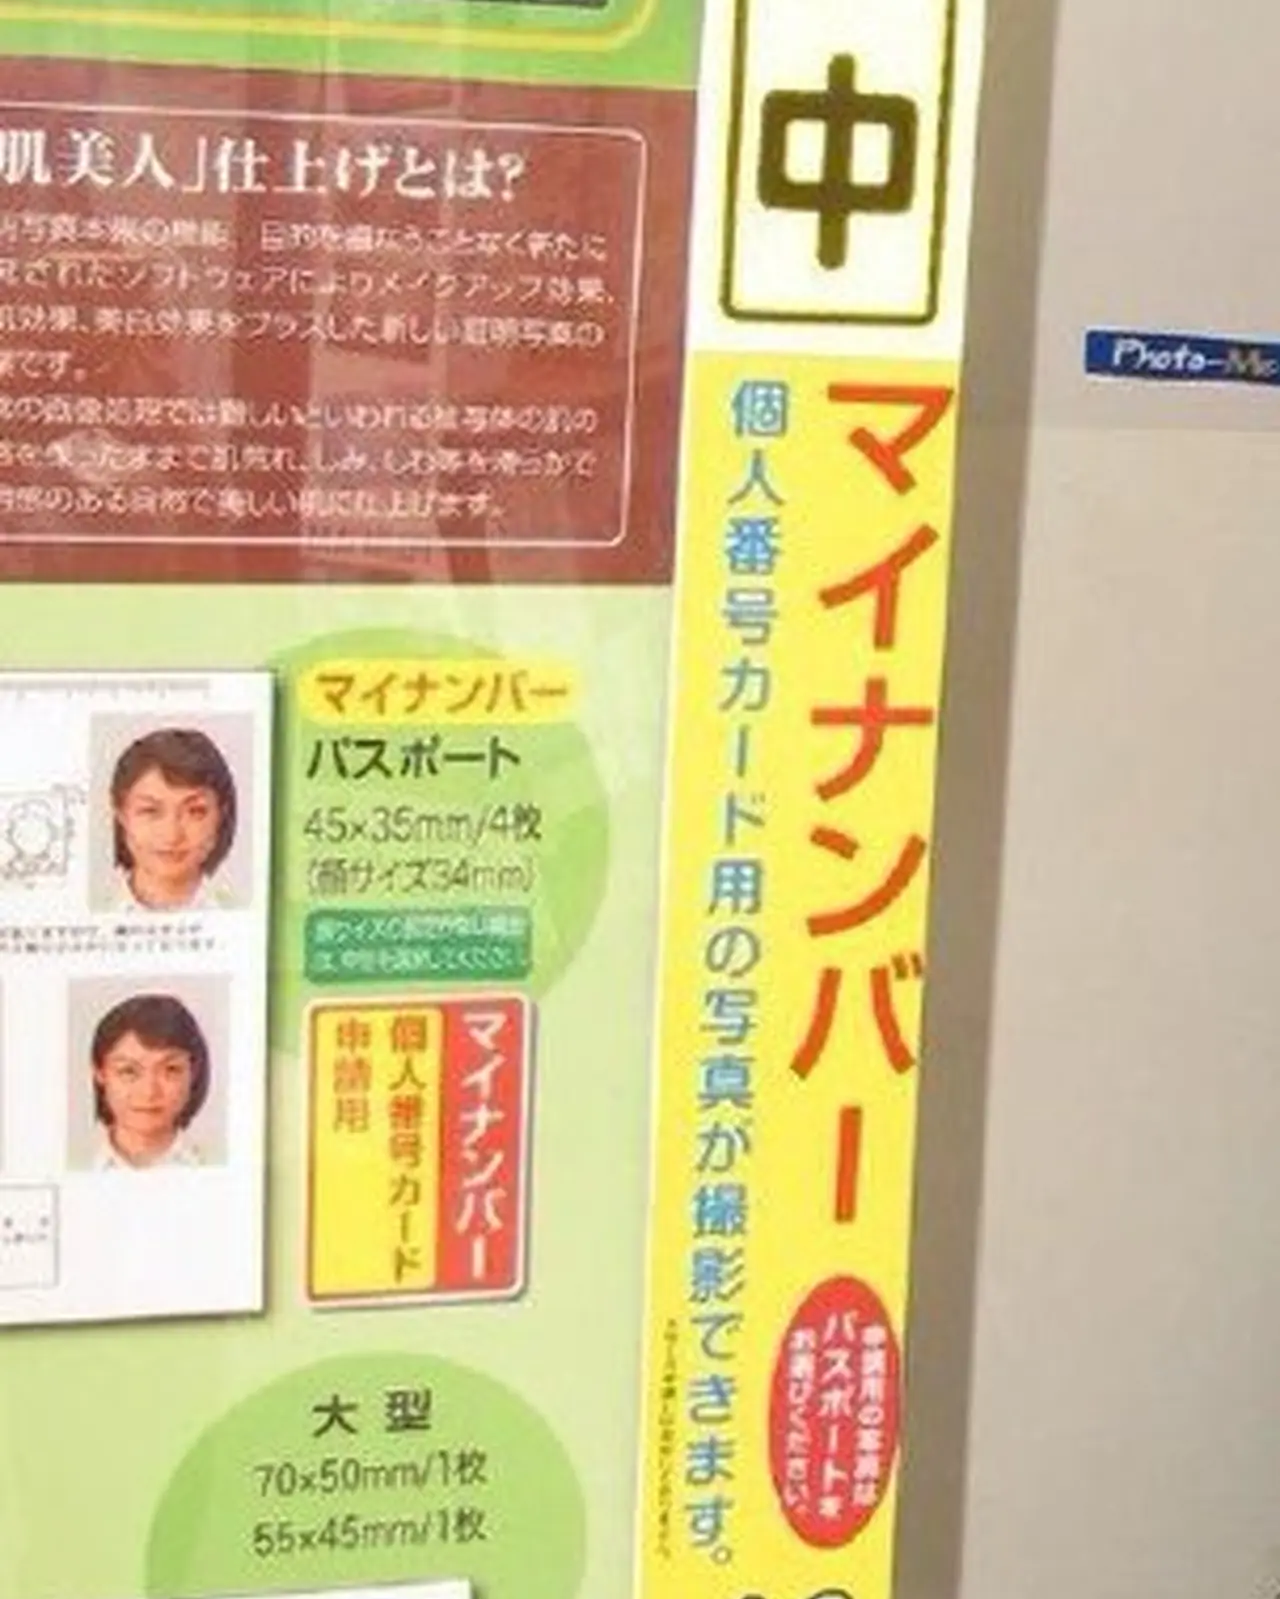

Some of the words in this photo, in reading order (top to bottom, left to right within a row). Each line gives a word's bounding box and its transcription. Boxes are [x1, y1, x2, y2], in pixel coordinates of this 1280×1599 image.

[306, 736, 522, 782] パスポート
[316, 671, 569, 717] マイナンバー
[789, 380, 956, 1223] マイナンバー
[330, 1017, 374, 1136] 申請用
[684, 378, 792, 1567] 個人番号カード用の写真が撮影できます。
[387, 1015, 431, 1286] 個人番号カード
[454, 1008, 507, 1282] マイナンバー
